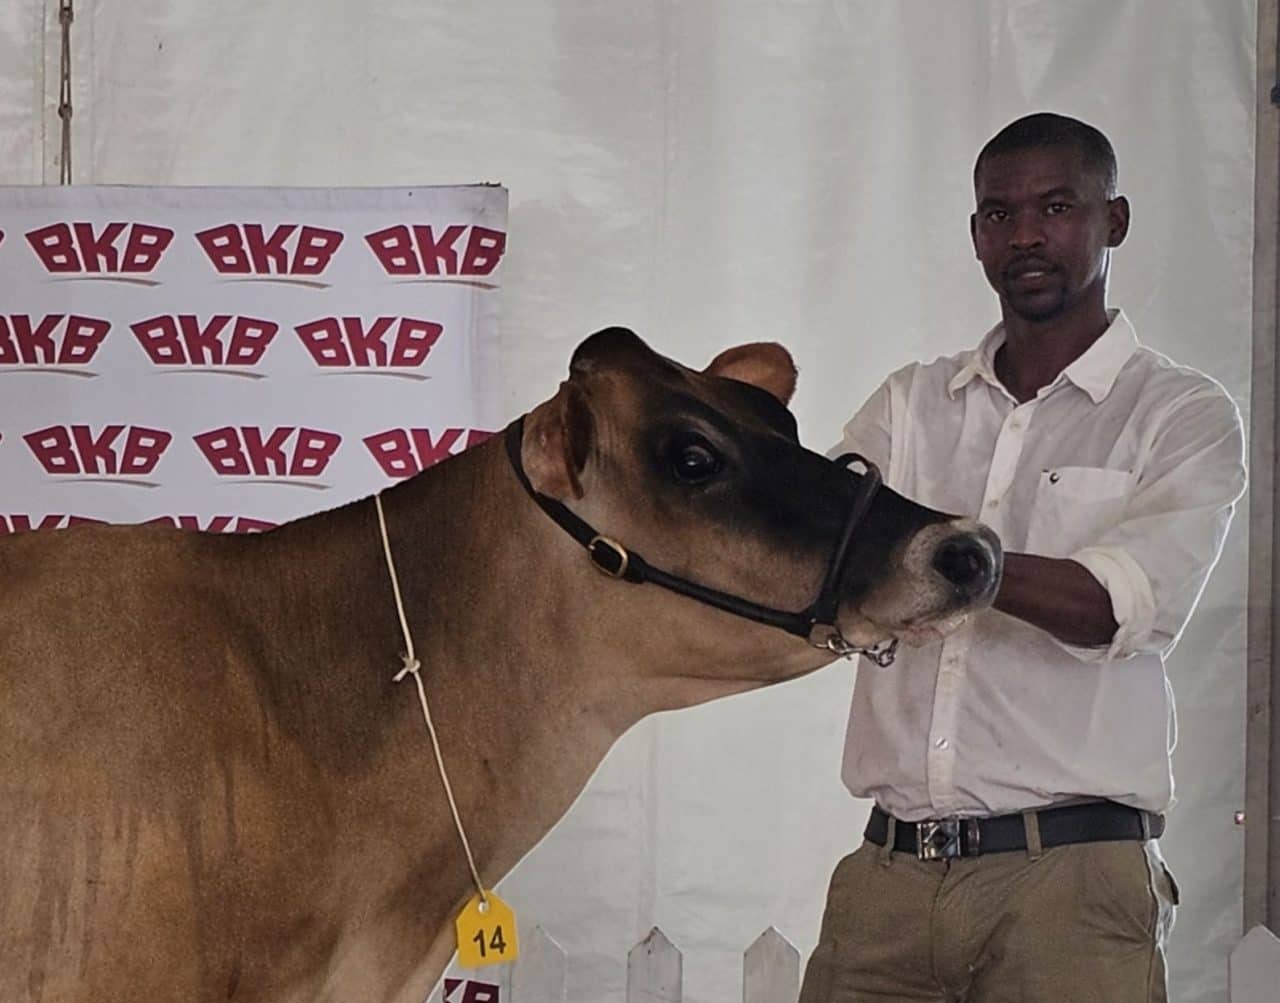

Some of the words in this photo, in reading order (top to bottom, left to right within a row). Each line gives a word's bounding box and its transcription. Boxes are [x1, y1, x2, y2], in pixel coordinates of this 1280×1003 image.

[25, 223, 173, 271] BKB
[196, 224, 342, 273] BKB
[365, 225, 505, 274] BKB
[131, 315, 278, 364] BKB
[295, 318, 441, 366] BKB
[22, 425, 171, 473] BKB
[193, 427, 340, 475] BKB
[363, 428, 496, 478] BK
[473, 925, 507, 958] 14
